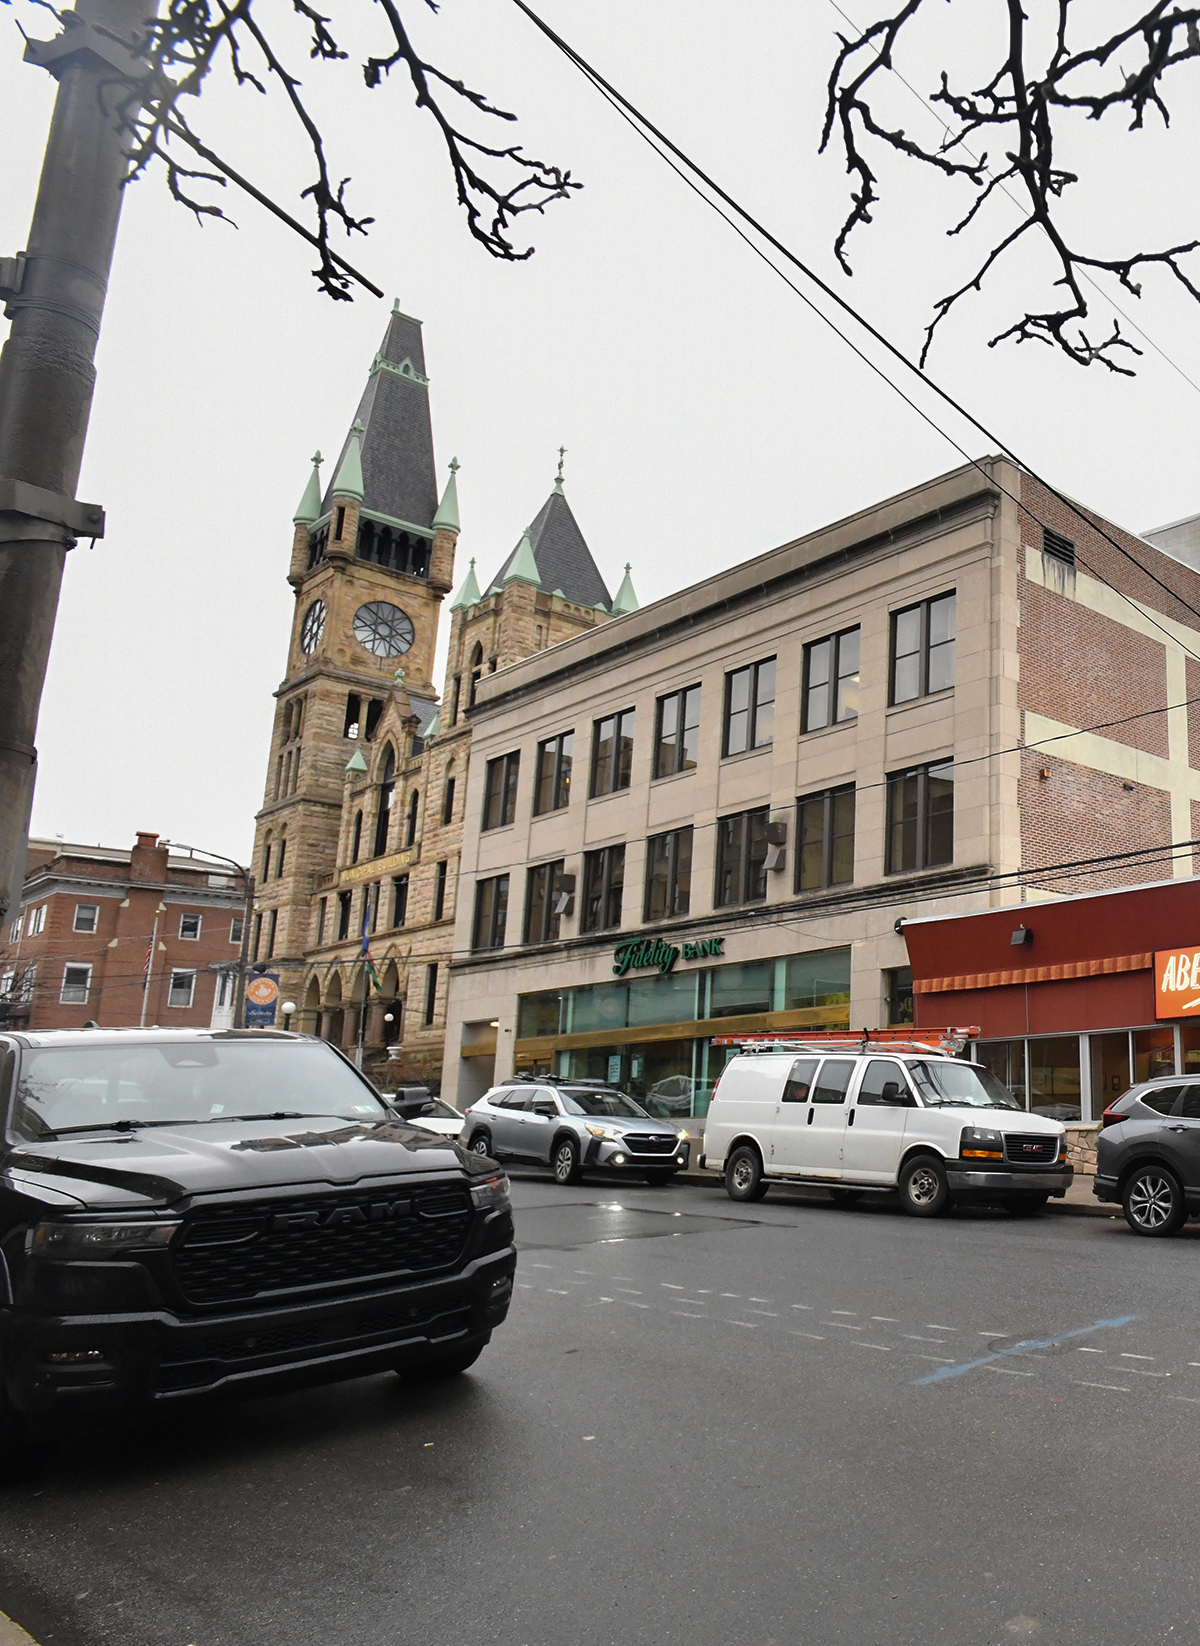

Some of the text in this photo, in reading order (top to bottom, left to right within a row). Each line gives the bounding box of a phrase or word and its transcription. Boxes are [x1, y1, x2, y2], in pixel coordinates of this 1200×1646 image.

[378, 852, 410, 870] BUILDING
[612, 937, 725, 976] Fidelity BANK
[1023, 1144, 1043, 1152] GMC
[274, 1200, 411, 1231] RAM
